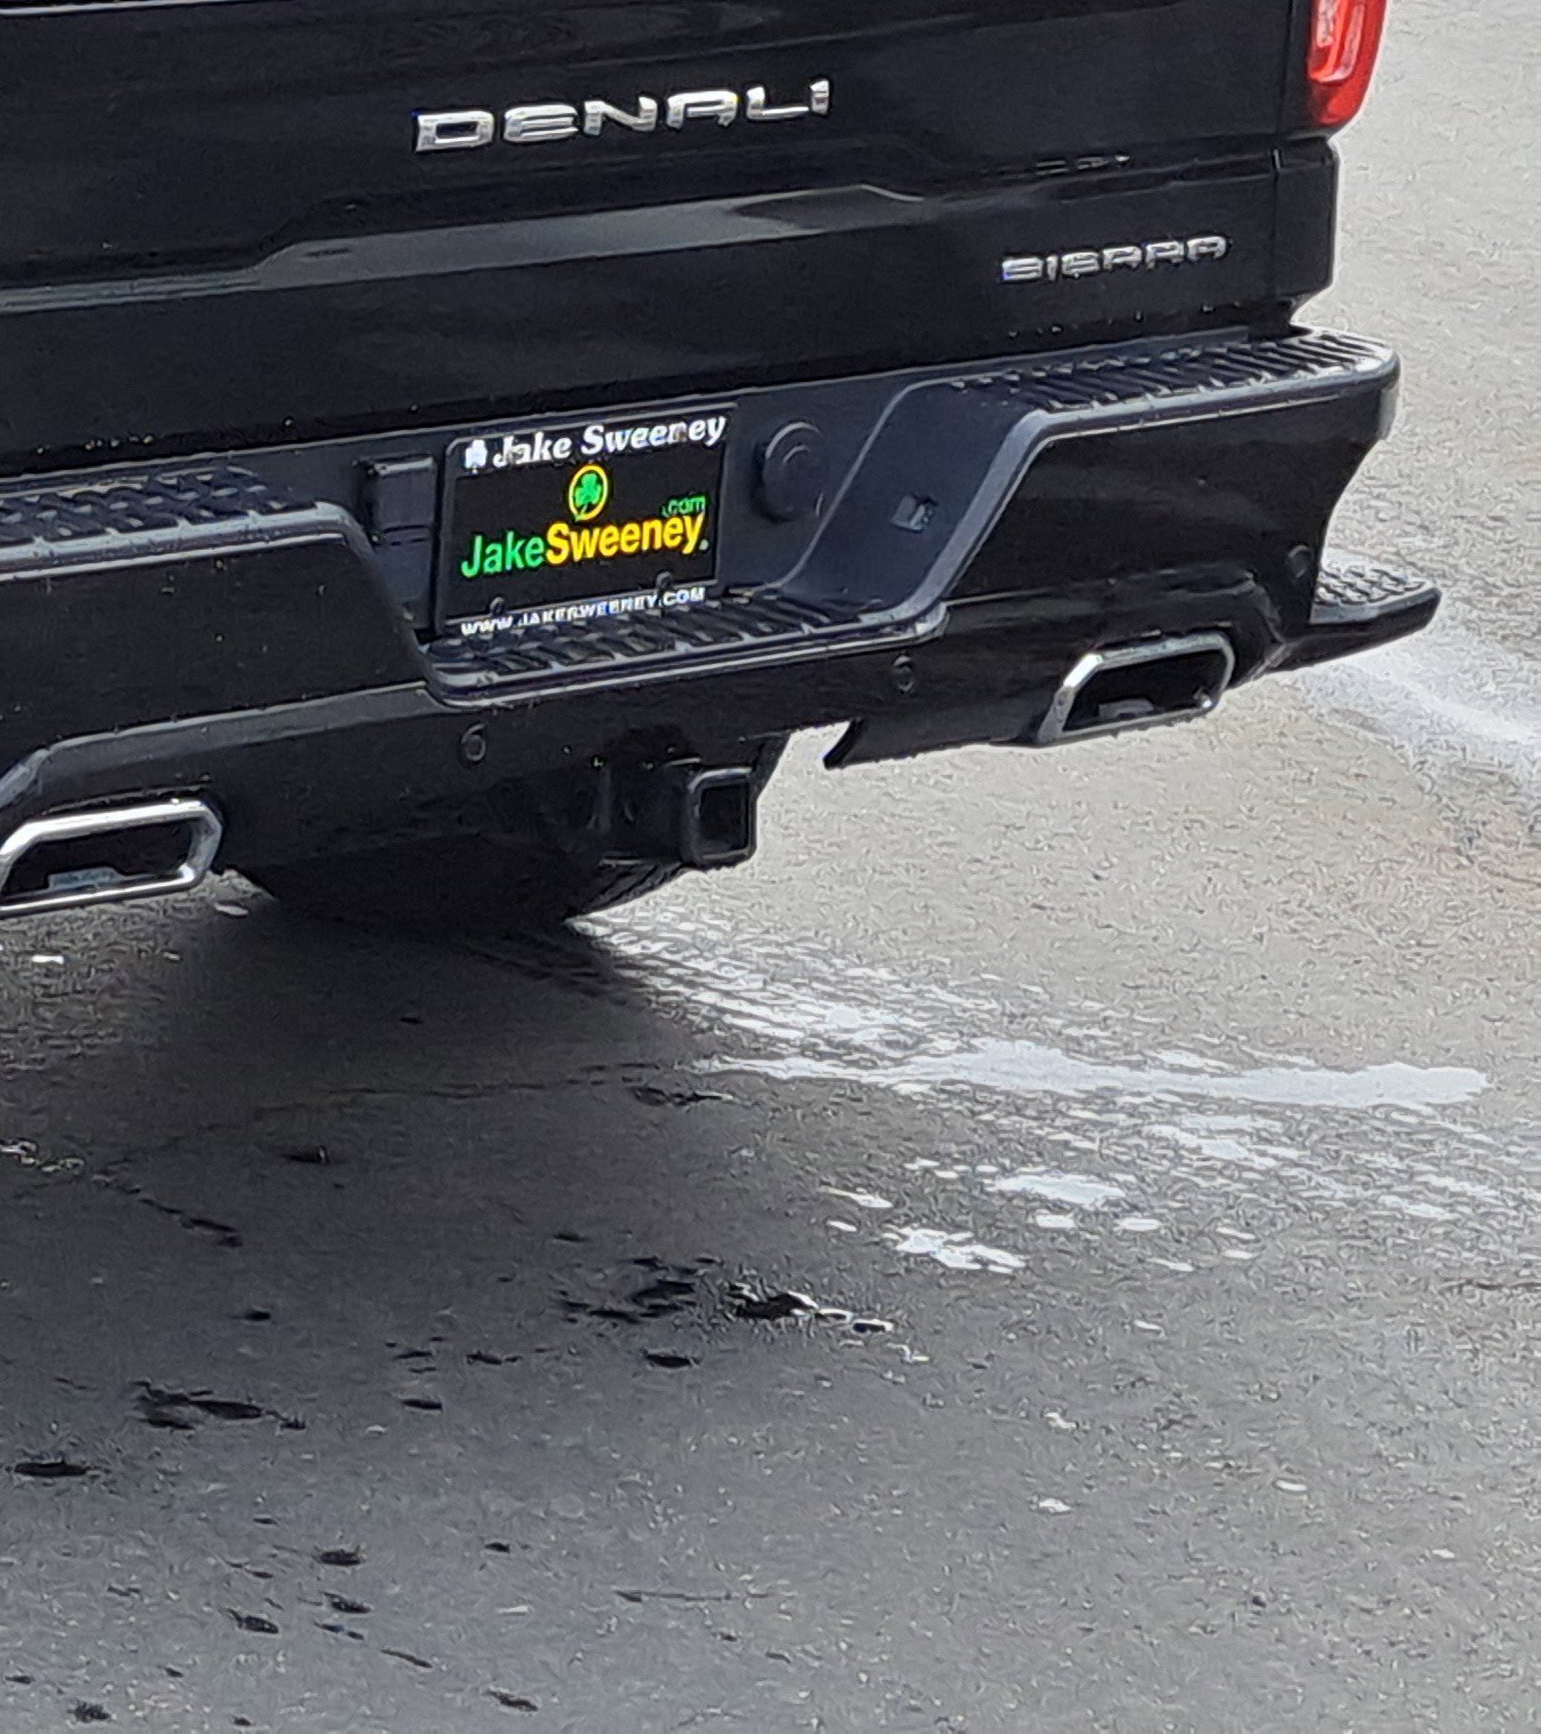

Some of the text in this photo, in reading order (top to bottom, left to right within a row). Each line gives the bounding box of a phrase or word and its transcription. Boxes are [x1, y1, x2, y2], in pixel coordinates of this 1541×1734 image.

[415, 79, 830, 153] DENALI
[1001, 235, 1228, 283] SIERRA
[492, 416, 727, 468] Jake Sweeney
[460, 513, 705, 578] JakeSweeney
